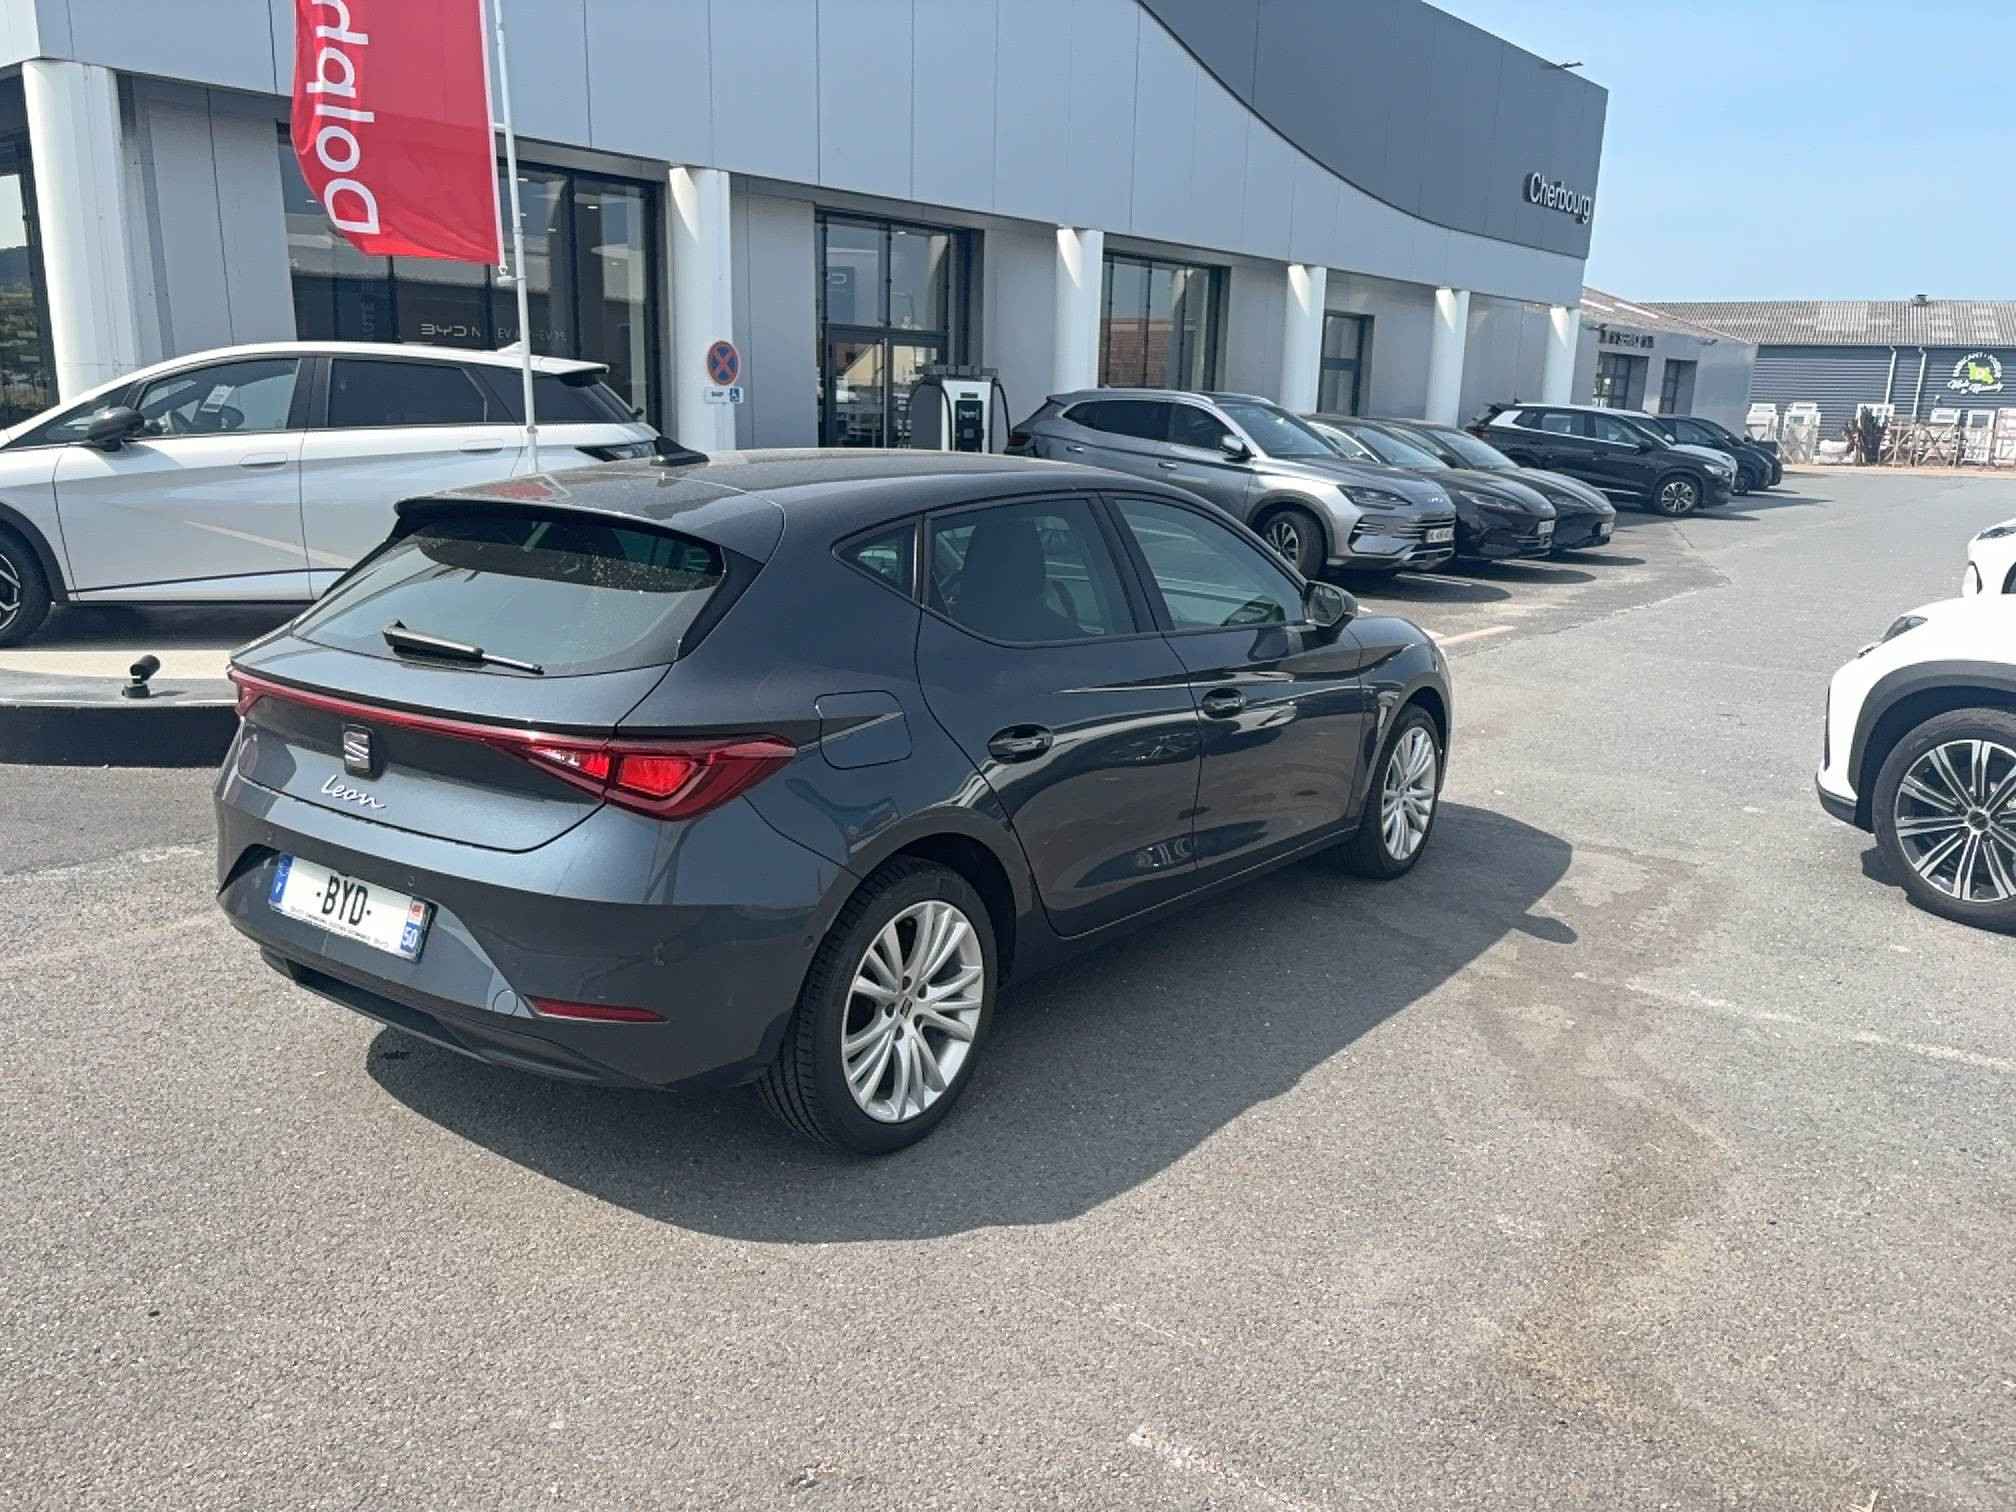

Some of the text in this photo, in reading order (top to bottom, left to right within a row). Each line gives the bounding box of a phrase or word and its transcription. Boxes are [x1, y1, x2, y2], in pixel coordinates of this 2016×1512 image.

[1529, 171, 1593, 225] Cherbourg
[420, 323, 467, 337] BYD
[320, 774, 387, 810] Leon
[402, 928, 418, 948] 50
